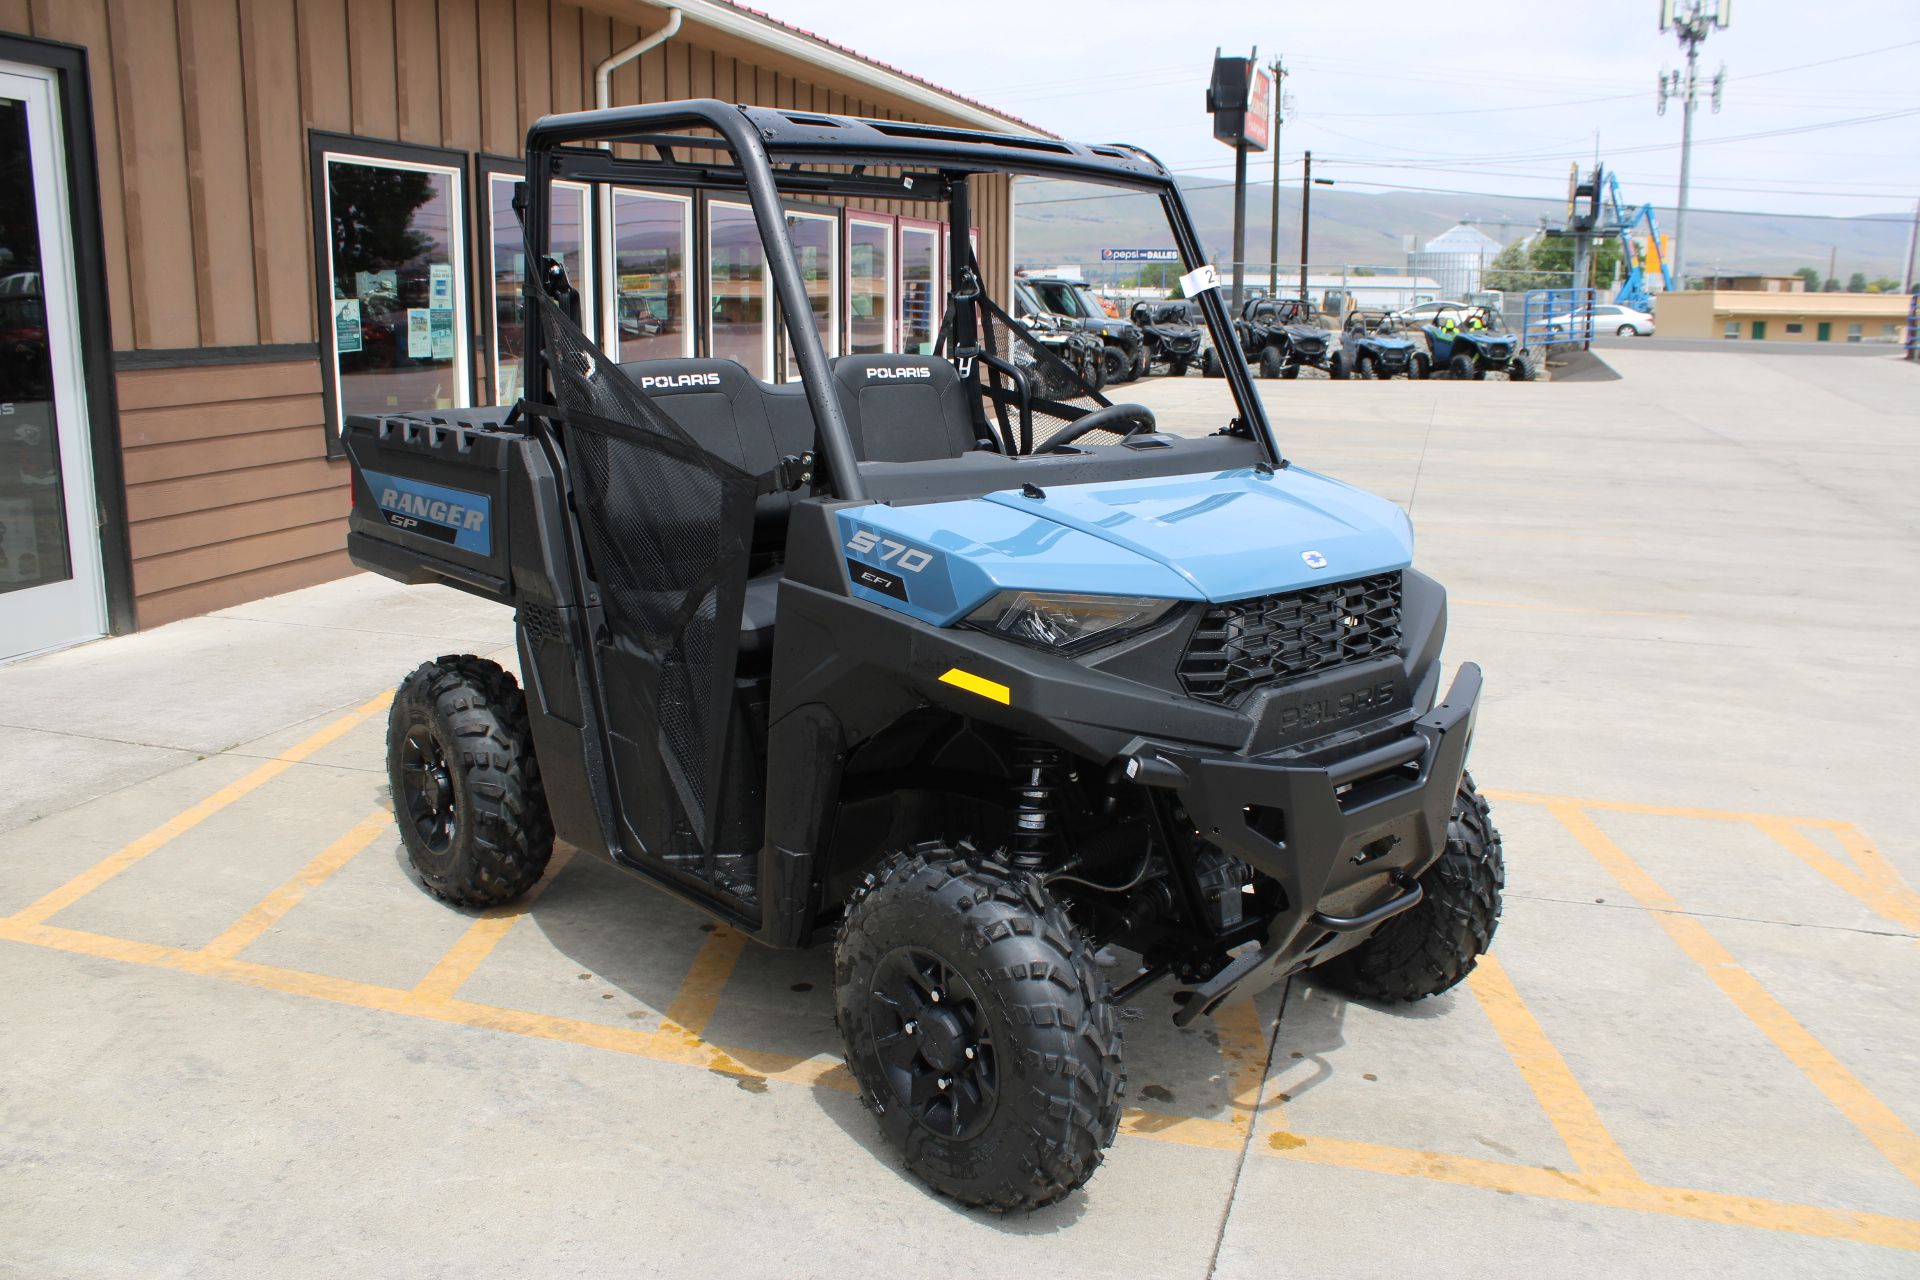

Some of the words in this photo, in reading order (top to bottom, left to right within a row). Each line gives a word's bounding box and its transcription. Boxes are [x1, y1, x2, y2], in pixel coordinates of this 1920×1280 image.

[1113, 250, 1139, 260] pepsi
[1147, 250, 1178, 260] DALLES
[641, 372, 721, 389] POLARIS
[866, 367, 931, 380] POLARIS
[380, 488, 485, 533] RANGER
[389, 513, 419, 529] SP
[846, 529, 934, 573] 570
[860, 571, 893, 589] EFI
[1278, 680, 1395, 735] POLARIS
